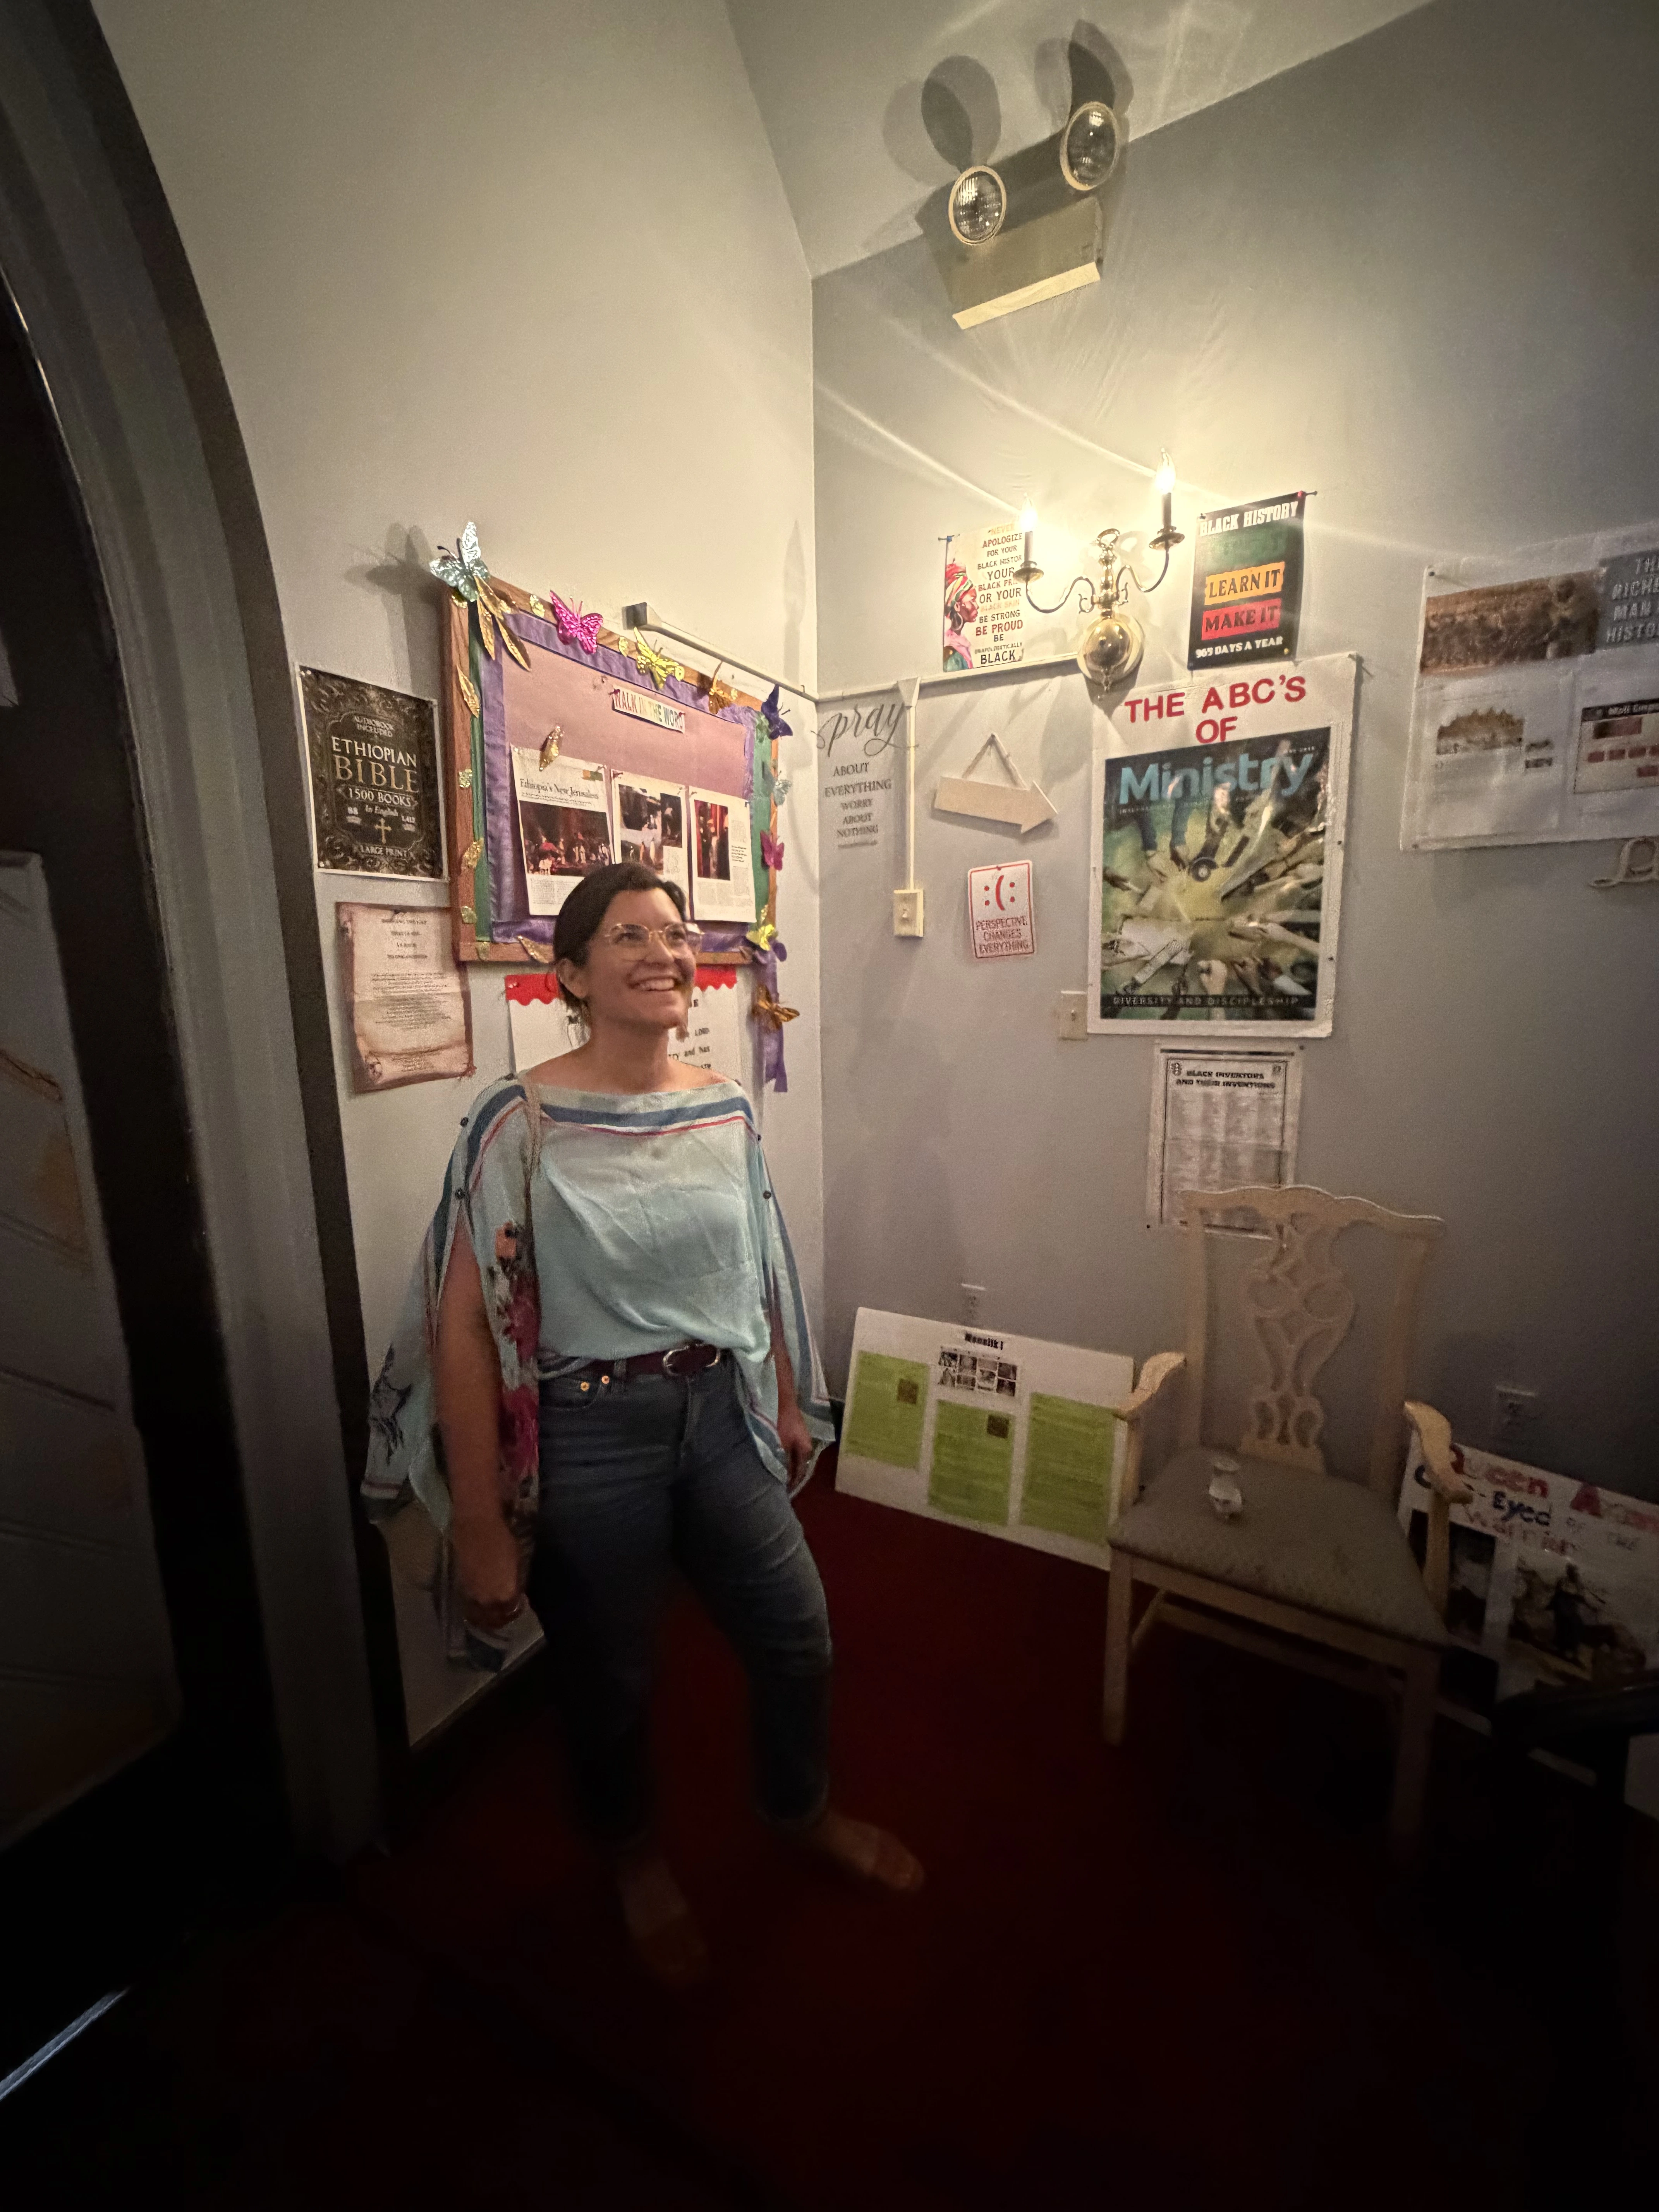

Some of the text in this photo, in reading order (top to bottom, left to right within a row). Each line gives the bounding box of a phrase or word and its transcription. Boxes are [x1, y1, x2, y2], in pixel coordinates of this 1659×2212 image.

[1200, 501, 1299, 537] BLACK HISTORY
[982, 533, 1022, 548] APOLOGIZE
[1001, 545, 1017, 554] YOUR
[977, 555, 1022, 570] BLACK HISTOR
[1635, 556, 1659, 575] TH
[987, 567, 1015, 580] YOUR
[978, 581, 1001, 591] BLACK
[1209, 569, 1281, 598] LEARN IT
[979, 587, 1022, 603] OR YOUR
[991, 610, 1020, 621] STRONG
[1614, 601, 1651, 620] MAN
[1205, 606, 1279, 632] MAKE IT
[976, 620, 1023, 636] BE PROUD
[1607, 622, 1659, 643] HISTO
[1214, 642, 1243, 655] DAYS
[1244, 641, 1252, 651] A
[1255, 636, 1283, 649] YEAR
[981, 649, 1015, 665] BLACK
[1125, 675, 1306, 723] THE ABC'S
[811, 704, 911, 757] pray
[1195, 716, 1238, 744] OF
[331, 736, 417, 768] ETHIOPIAN
[333, 754, 419, 793] BIBLE
[833, 762, 869, 776] ABOUT
[1120, 753, 1314, 804] Ministry
[824, 779, 891, 797] EVERYTHING
[349, 787, 411, 807] 1500 BOOKS
[841, 799, 873, 810] WORRY
[842, 813, 873, 825] ABOUT
[837, 824, 878, 837] NOTHING
[975, 915, 1027, 930] PERSPECTIVE
[979, 939, 1029, 954] EVERYTHING
[1113, 996, 1298, 1006] DIVERSITY AND DISCIPLESHIP
